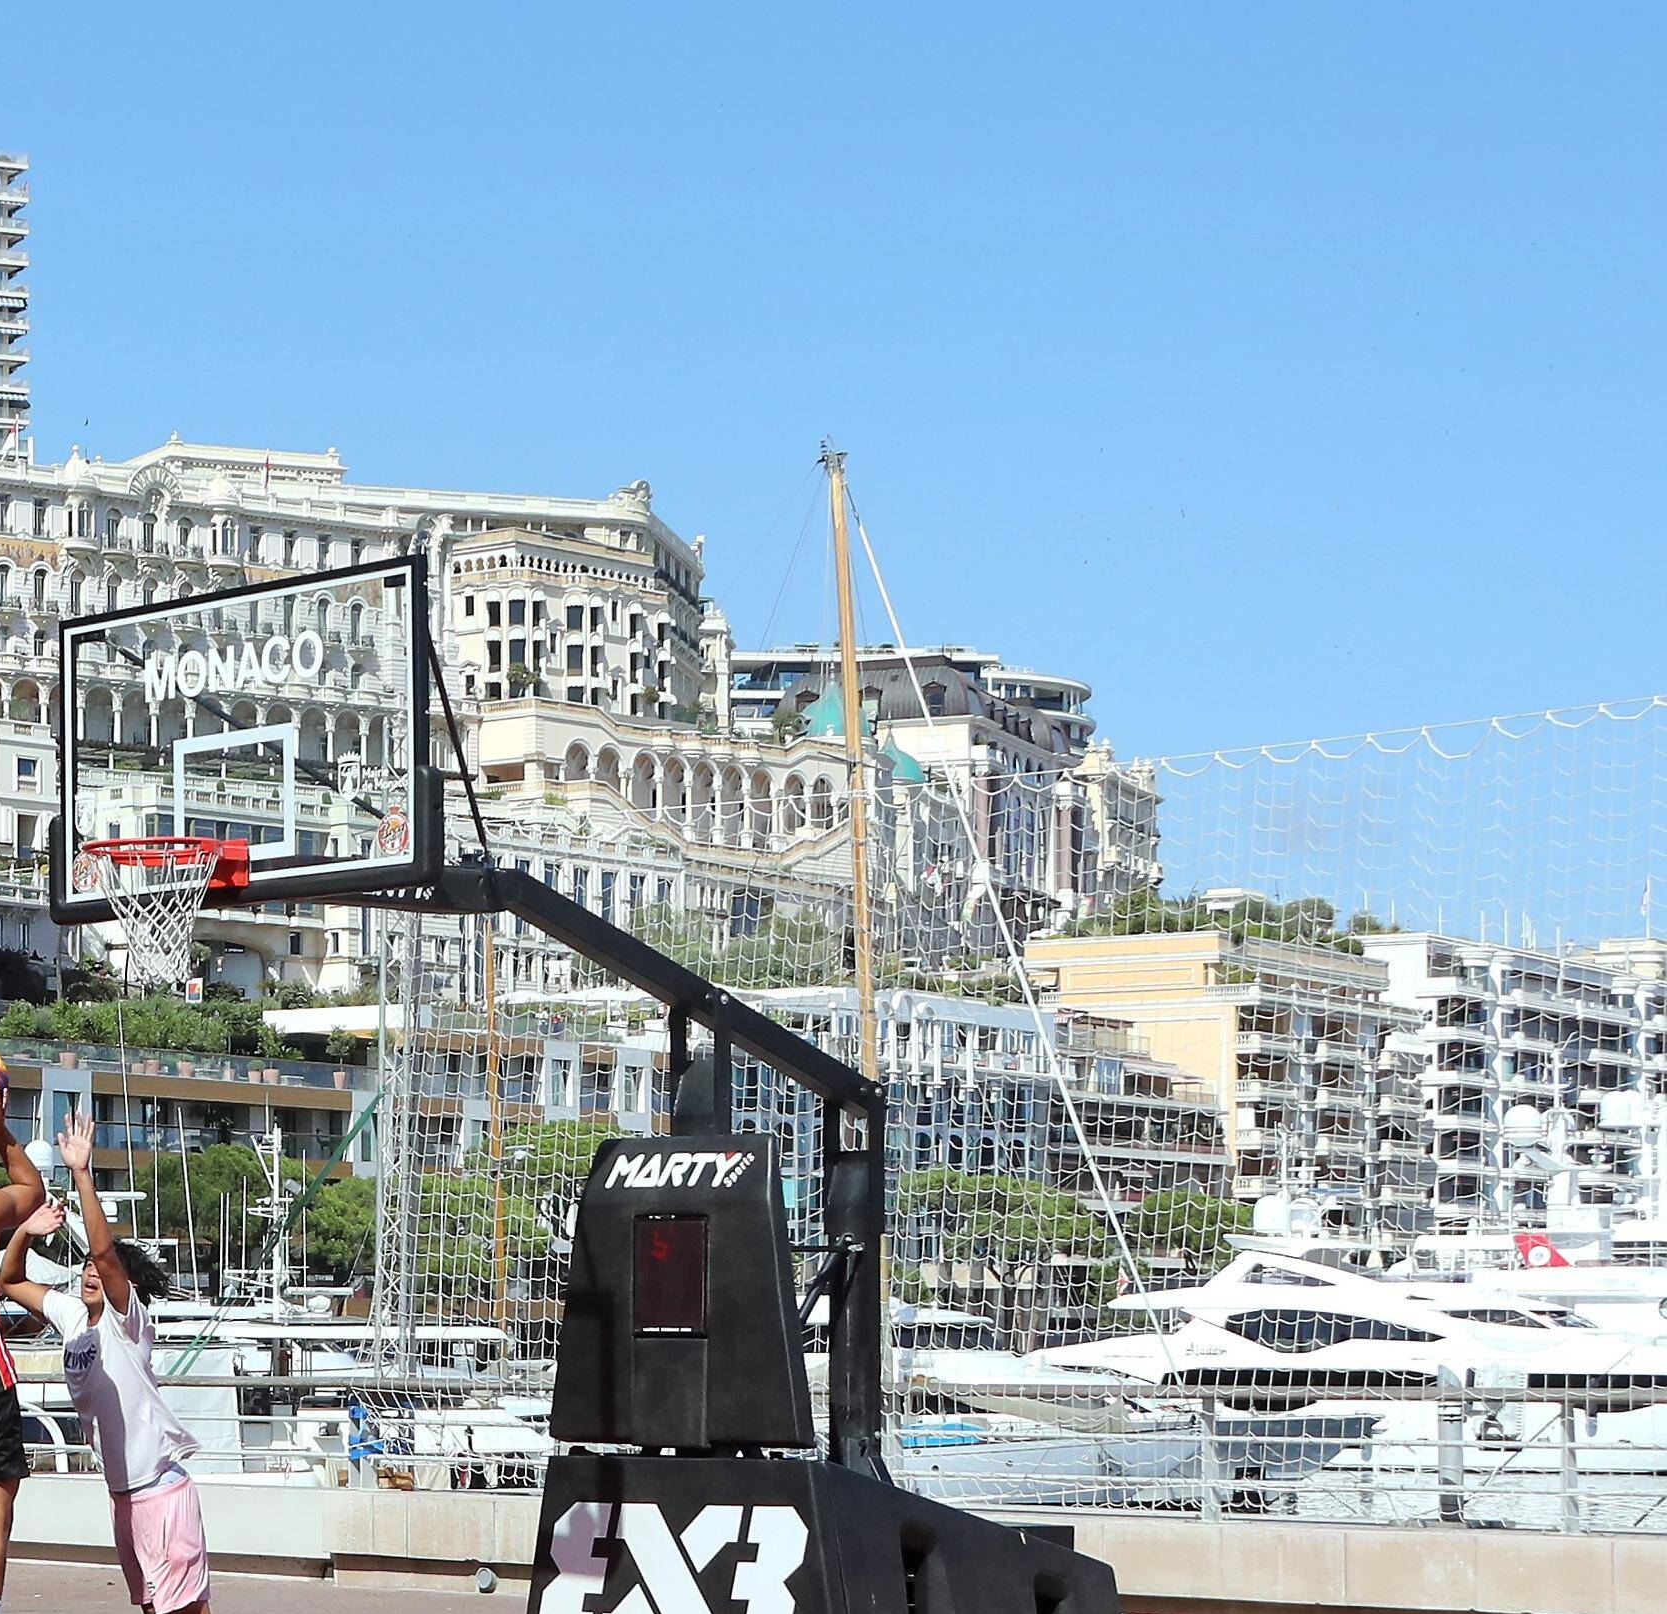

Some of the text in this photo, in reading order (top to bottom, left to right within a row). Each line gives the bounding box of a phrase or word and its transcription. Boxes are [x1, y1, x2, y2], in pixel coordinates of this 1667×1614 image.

[144, 630, 324, 703] MONACO
[362, 766, 389, 779] Mairie
[362, 781, 373, 791] de
[605, 1152, 743, 1189] MARTY
